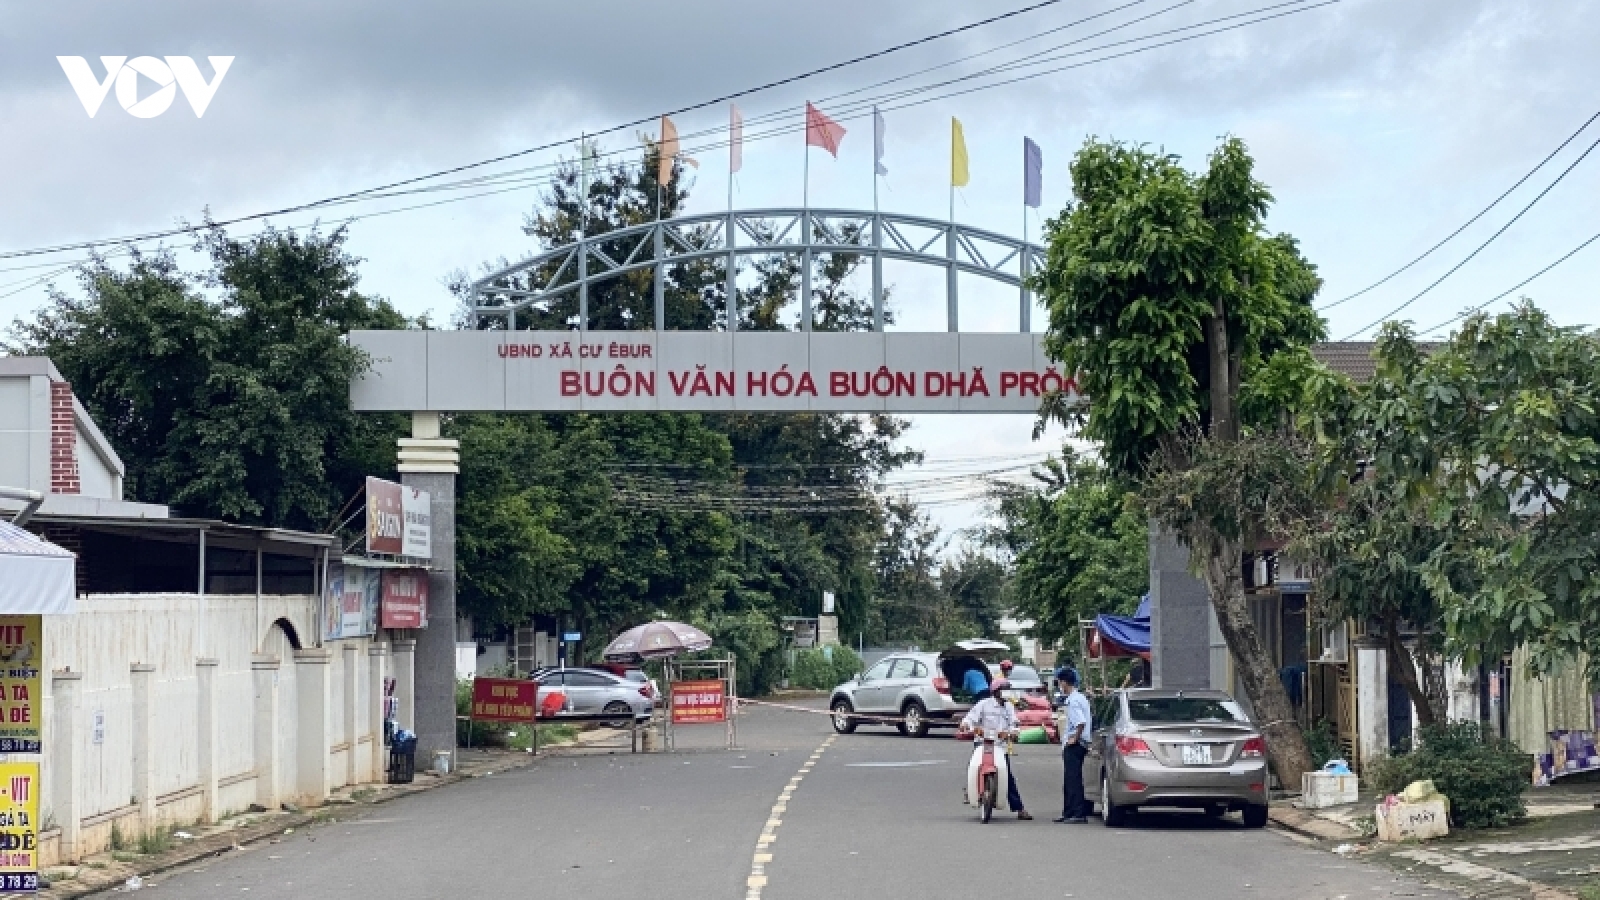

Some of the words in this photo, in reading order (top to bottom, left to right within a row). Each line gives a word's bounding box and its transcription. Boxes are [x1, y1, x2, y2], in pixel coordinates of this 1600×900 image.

[498, 344, 542, 358] UBND
[549, 341, 573, 358] XÃ
[578, 344, 603, 358] CƯ
[609, 341, 653, 358] ÊBUR
[560, 364, 655, 396] BUÔN
[668, 364, 735, 396] VĂN
[747, 364, 818, 396] HÓA
[830, 366, 915, 397] BUÔN
[924, 366, 990, 397] DHĂ
[12, 685, 28, 700] TA
[12, 777, 31, 806] VỊT
